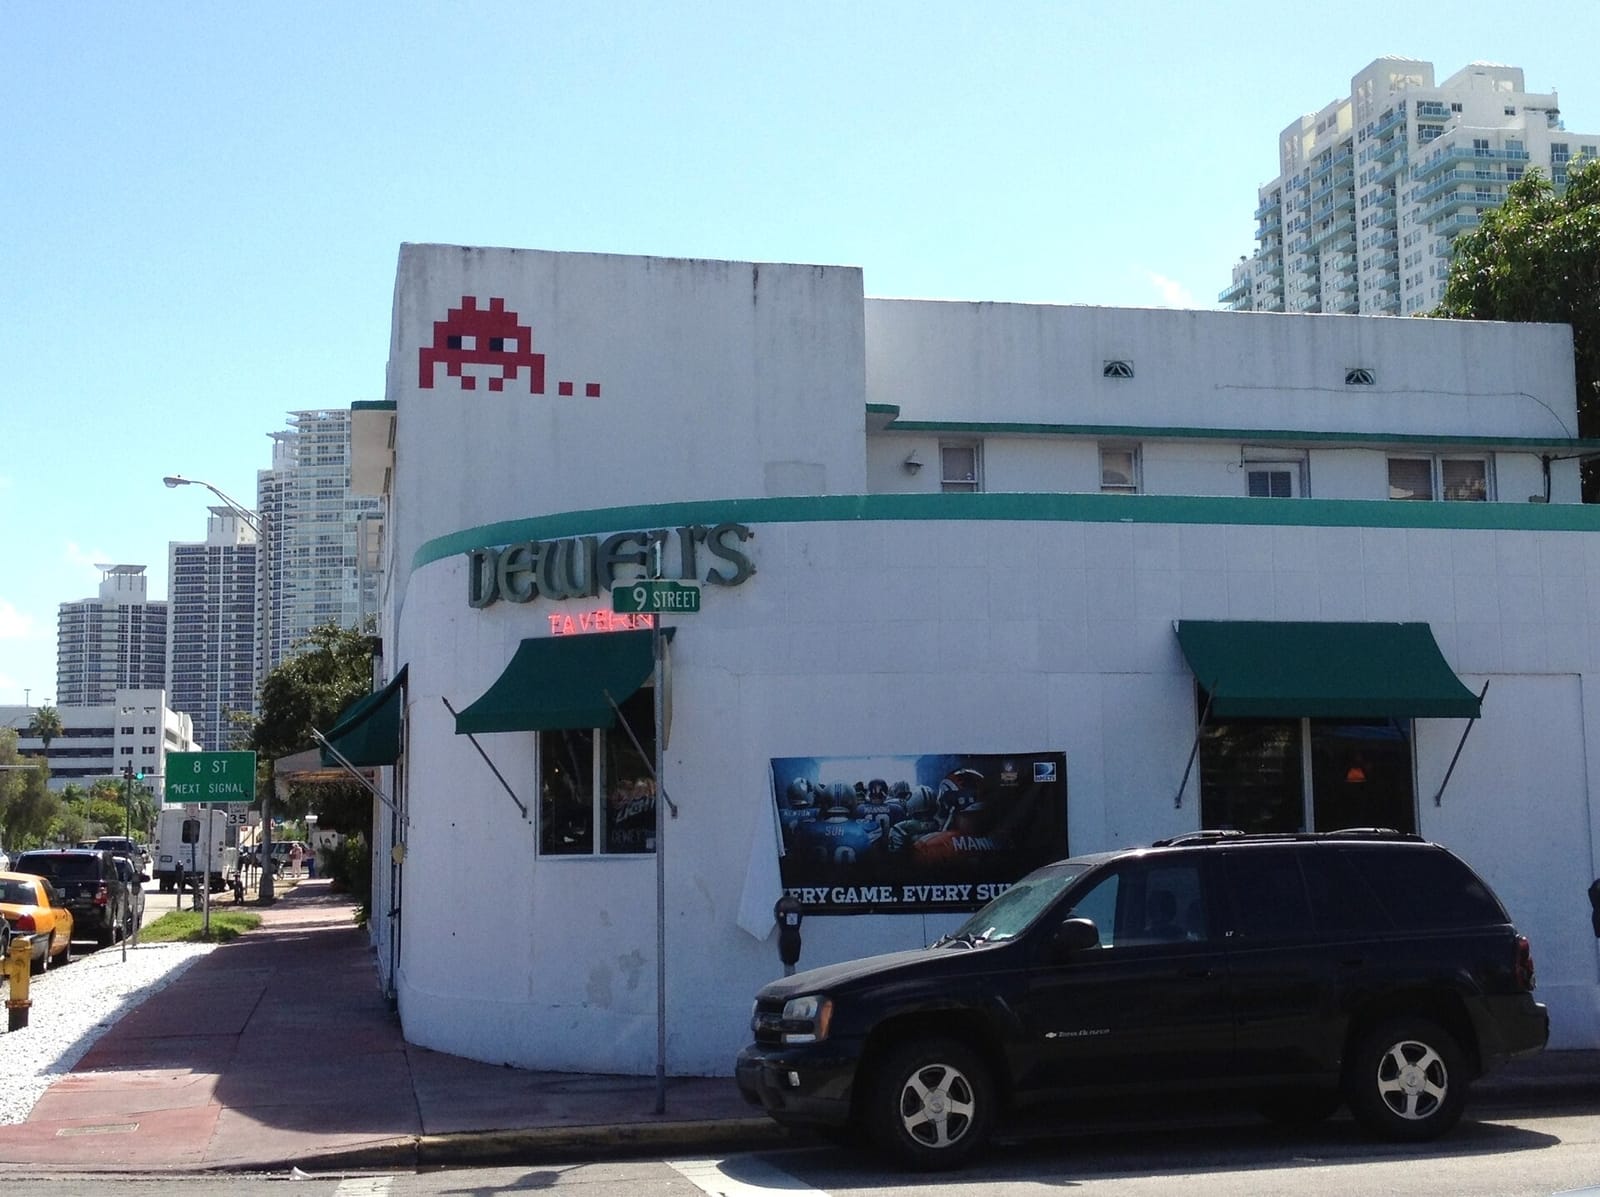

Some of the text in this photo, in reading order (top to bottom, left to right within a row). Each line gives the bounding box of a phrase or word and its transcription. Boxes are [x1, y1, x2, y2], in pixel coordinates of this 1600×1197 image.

[633, 587, 697, 611] 9 STREET
[548, 610, 654, 635] TAVERN
[193, 760, 228, 774] 8 ST
[175, 783, 244, 794] NEXT SIGNAL
[229, 814, 247, 824] 35
[825, 826, 845, 837] SUH
[783, 884, 1013, 903] ERY GAME. EVERY SU
